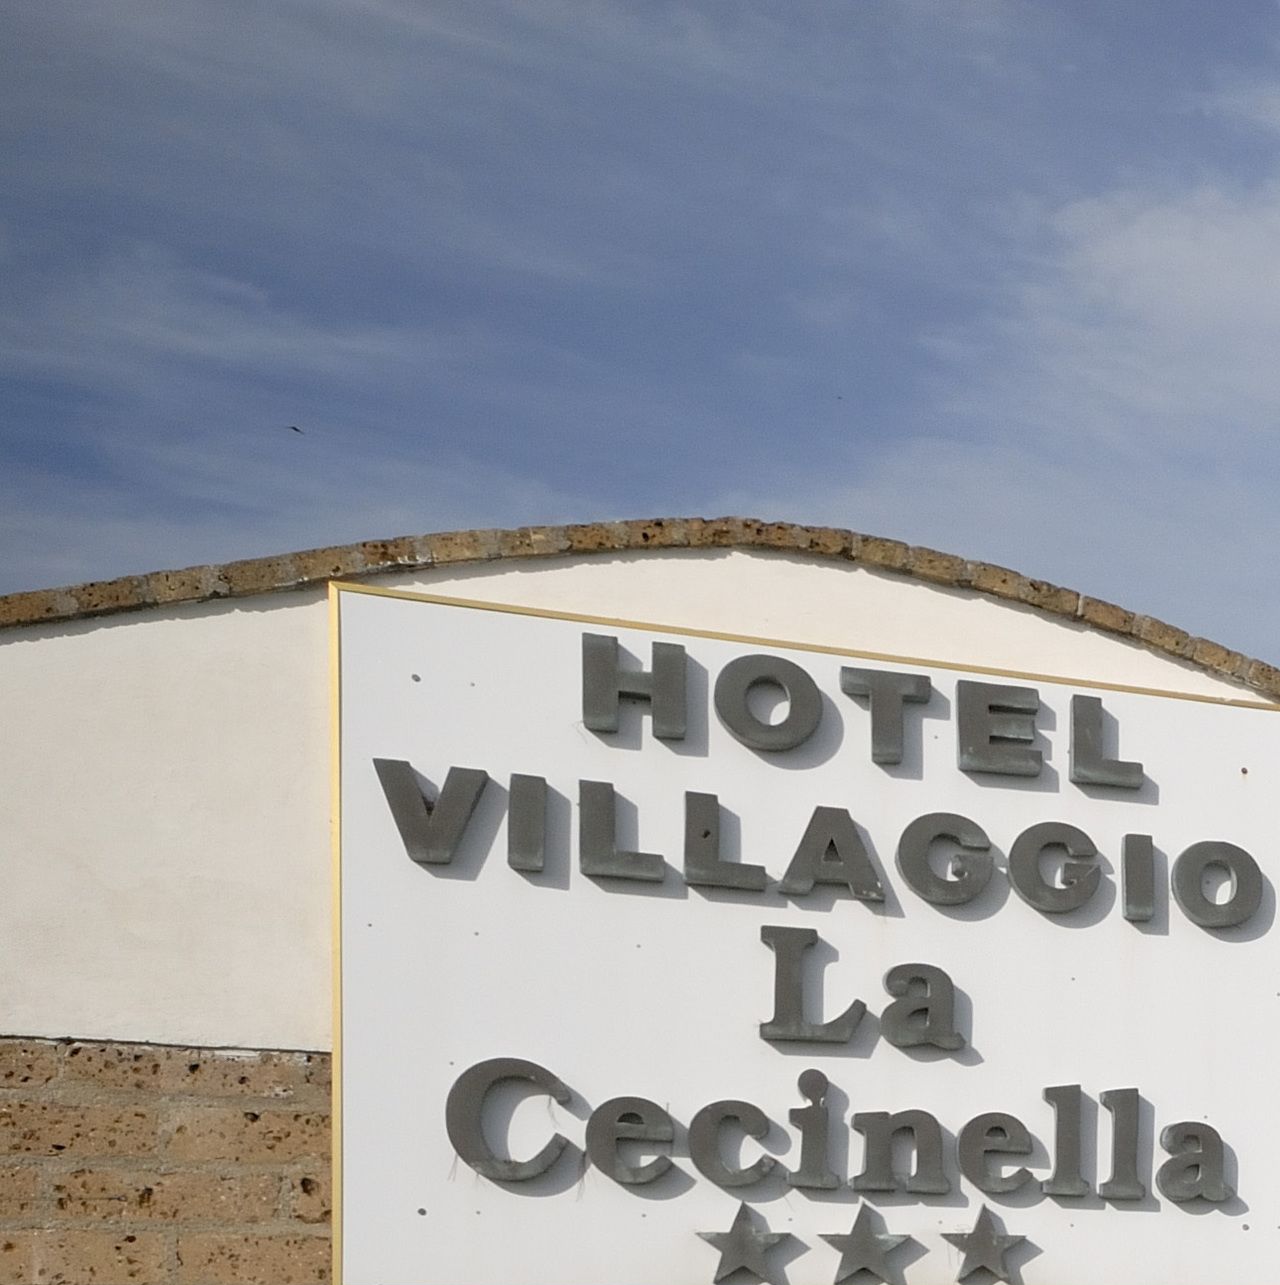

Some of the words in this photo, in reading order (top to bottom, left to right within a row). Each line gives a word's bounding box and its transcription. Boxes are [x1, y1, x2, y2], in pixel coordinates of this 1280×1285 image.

[582, 632, 1143, 789] HOTEL
[373, 757, 1264, 929] VILLAGGIO
[759, 924, 966, 1051] La
[445, 1057, 1239, 1202] Cecinella
